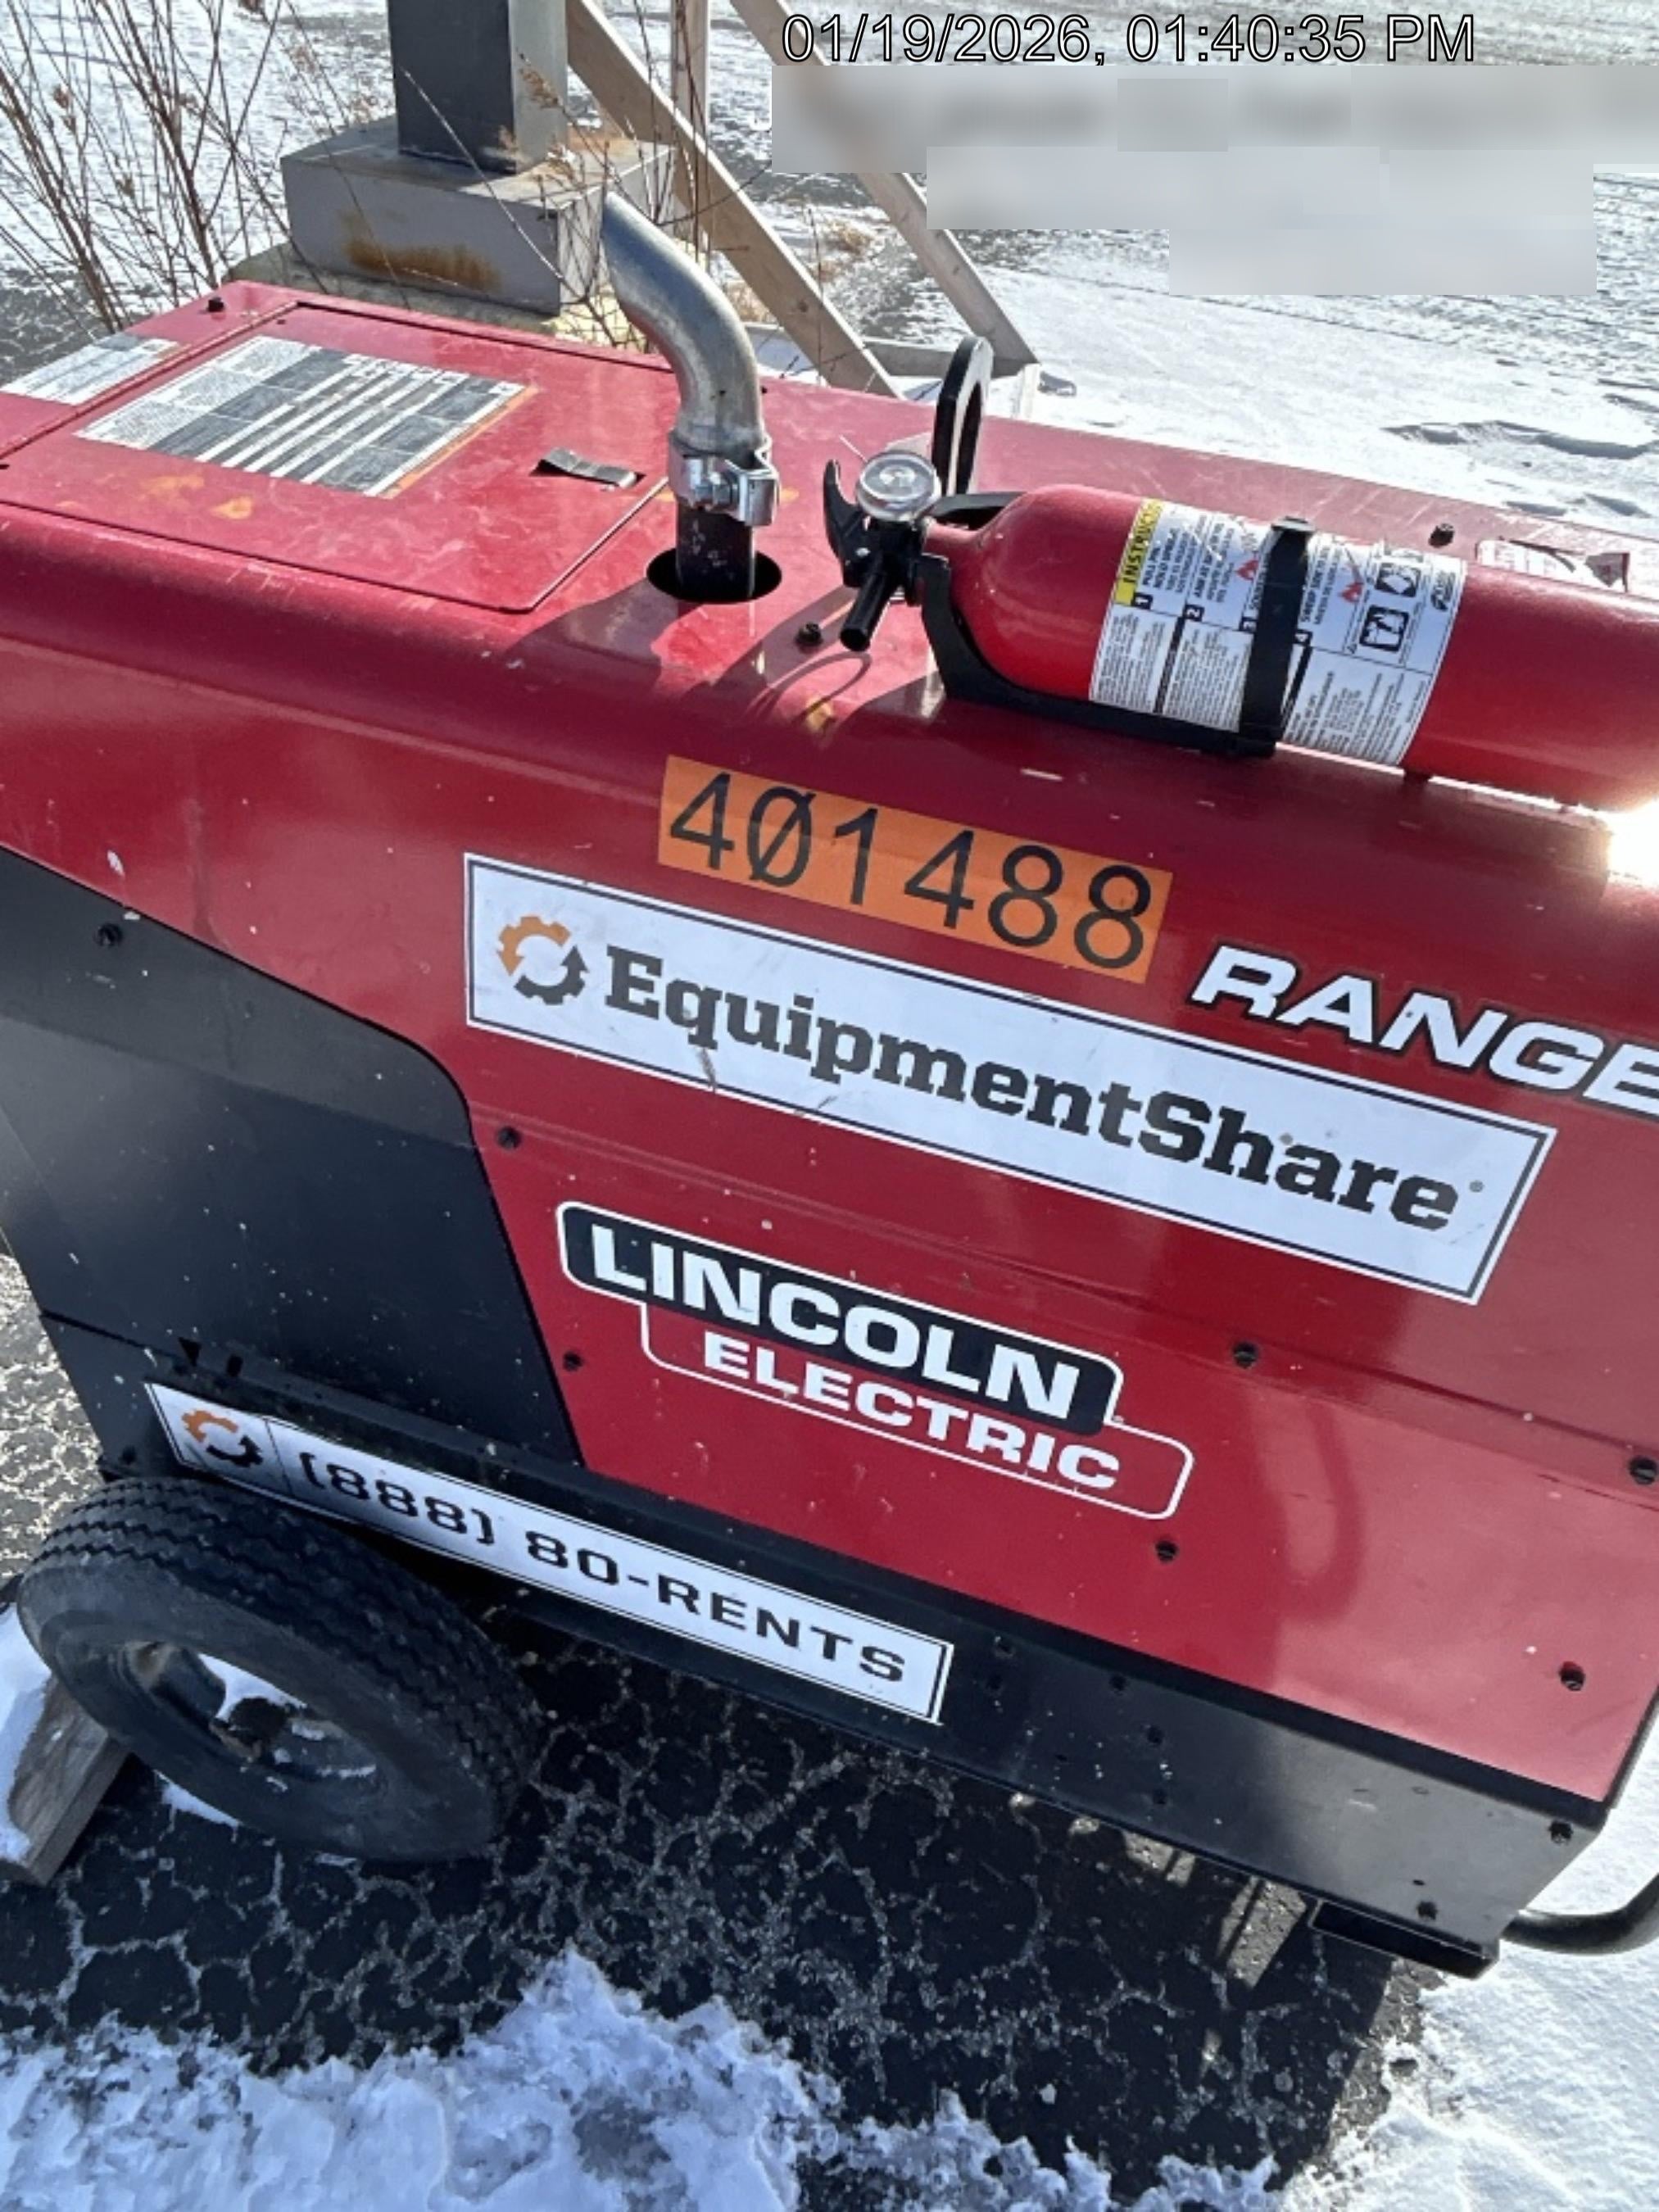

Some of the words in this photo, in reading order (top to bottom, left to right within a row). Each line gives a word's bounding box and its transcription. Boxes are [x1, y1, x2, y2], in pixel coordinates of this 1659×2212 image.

[669, 771, 1151, 969] 401488
[605, 945, 1460, 1231] EquipmentShare
[592, 1224, 1081, 1420] LINCOLN
[704, 1330, 1120, 1490] ELECTRIC
[299, 1452, 495, 1544] (888)
[525, 1530, 906, 1683] 80-RENTS
